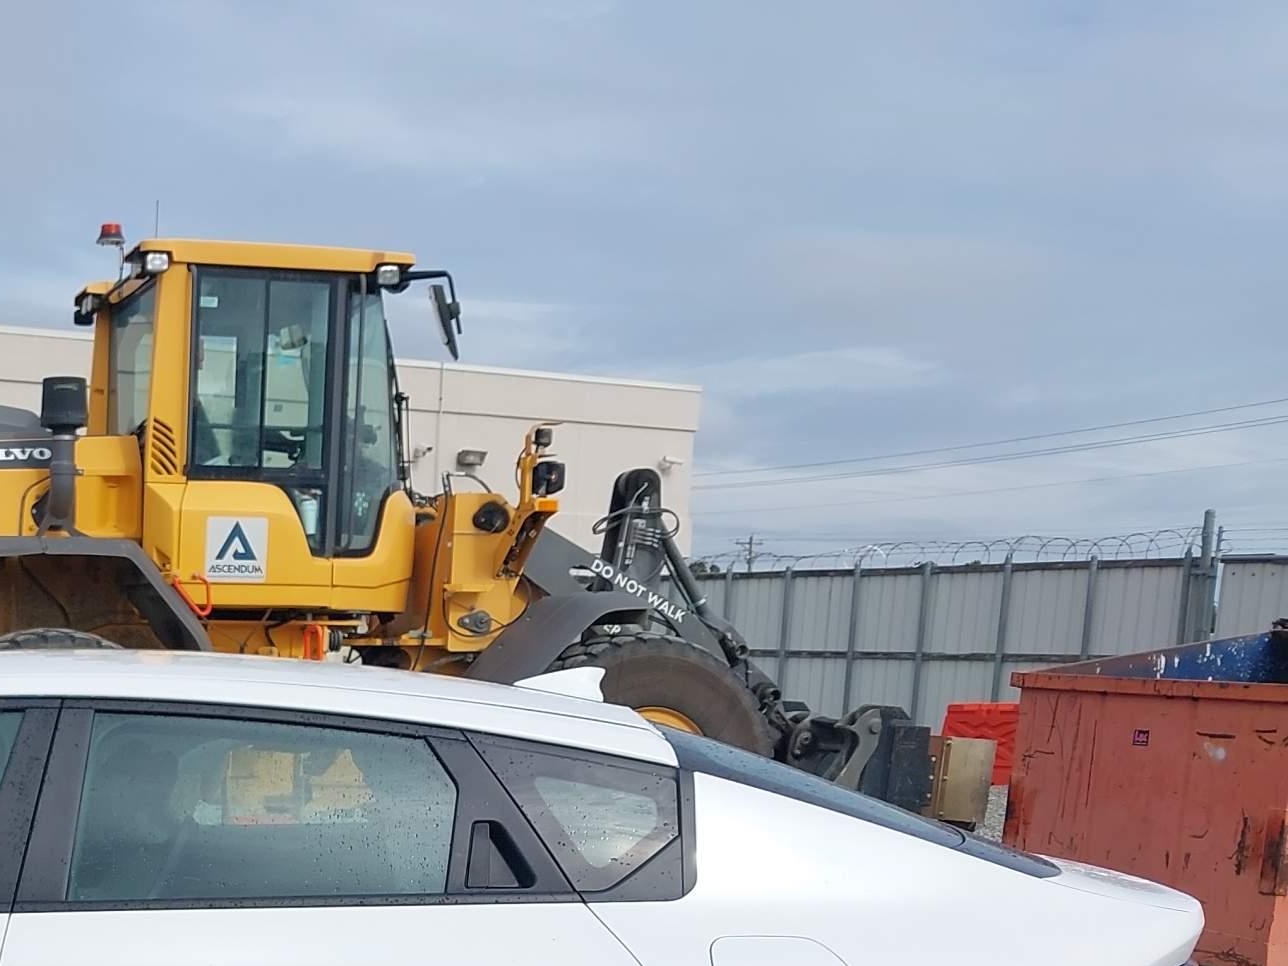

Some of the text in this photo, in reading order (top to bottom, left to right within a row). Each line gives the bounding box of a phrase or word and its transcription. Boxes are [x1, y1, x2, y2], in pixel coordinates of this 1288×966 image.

[208, 564, 263, 574] ASCENDUM
[591, 559, 686, 623] DO NOT WALK
